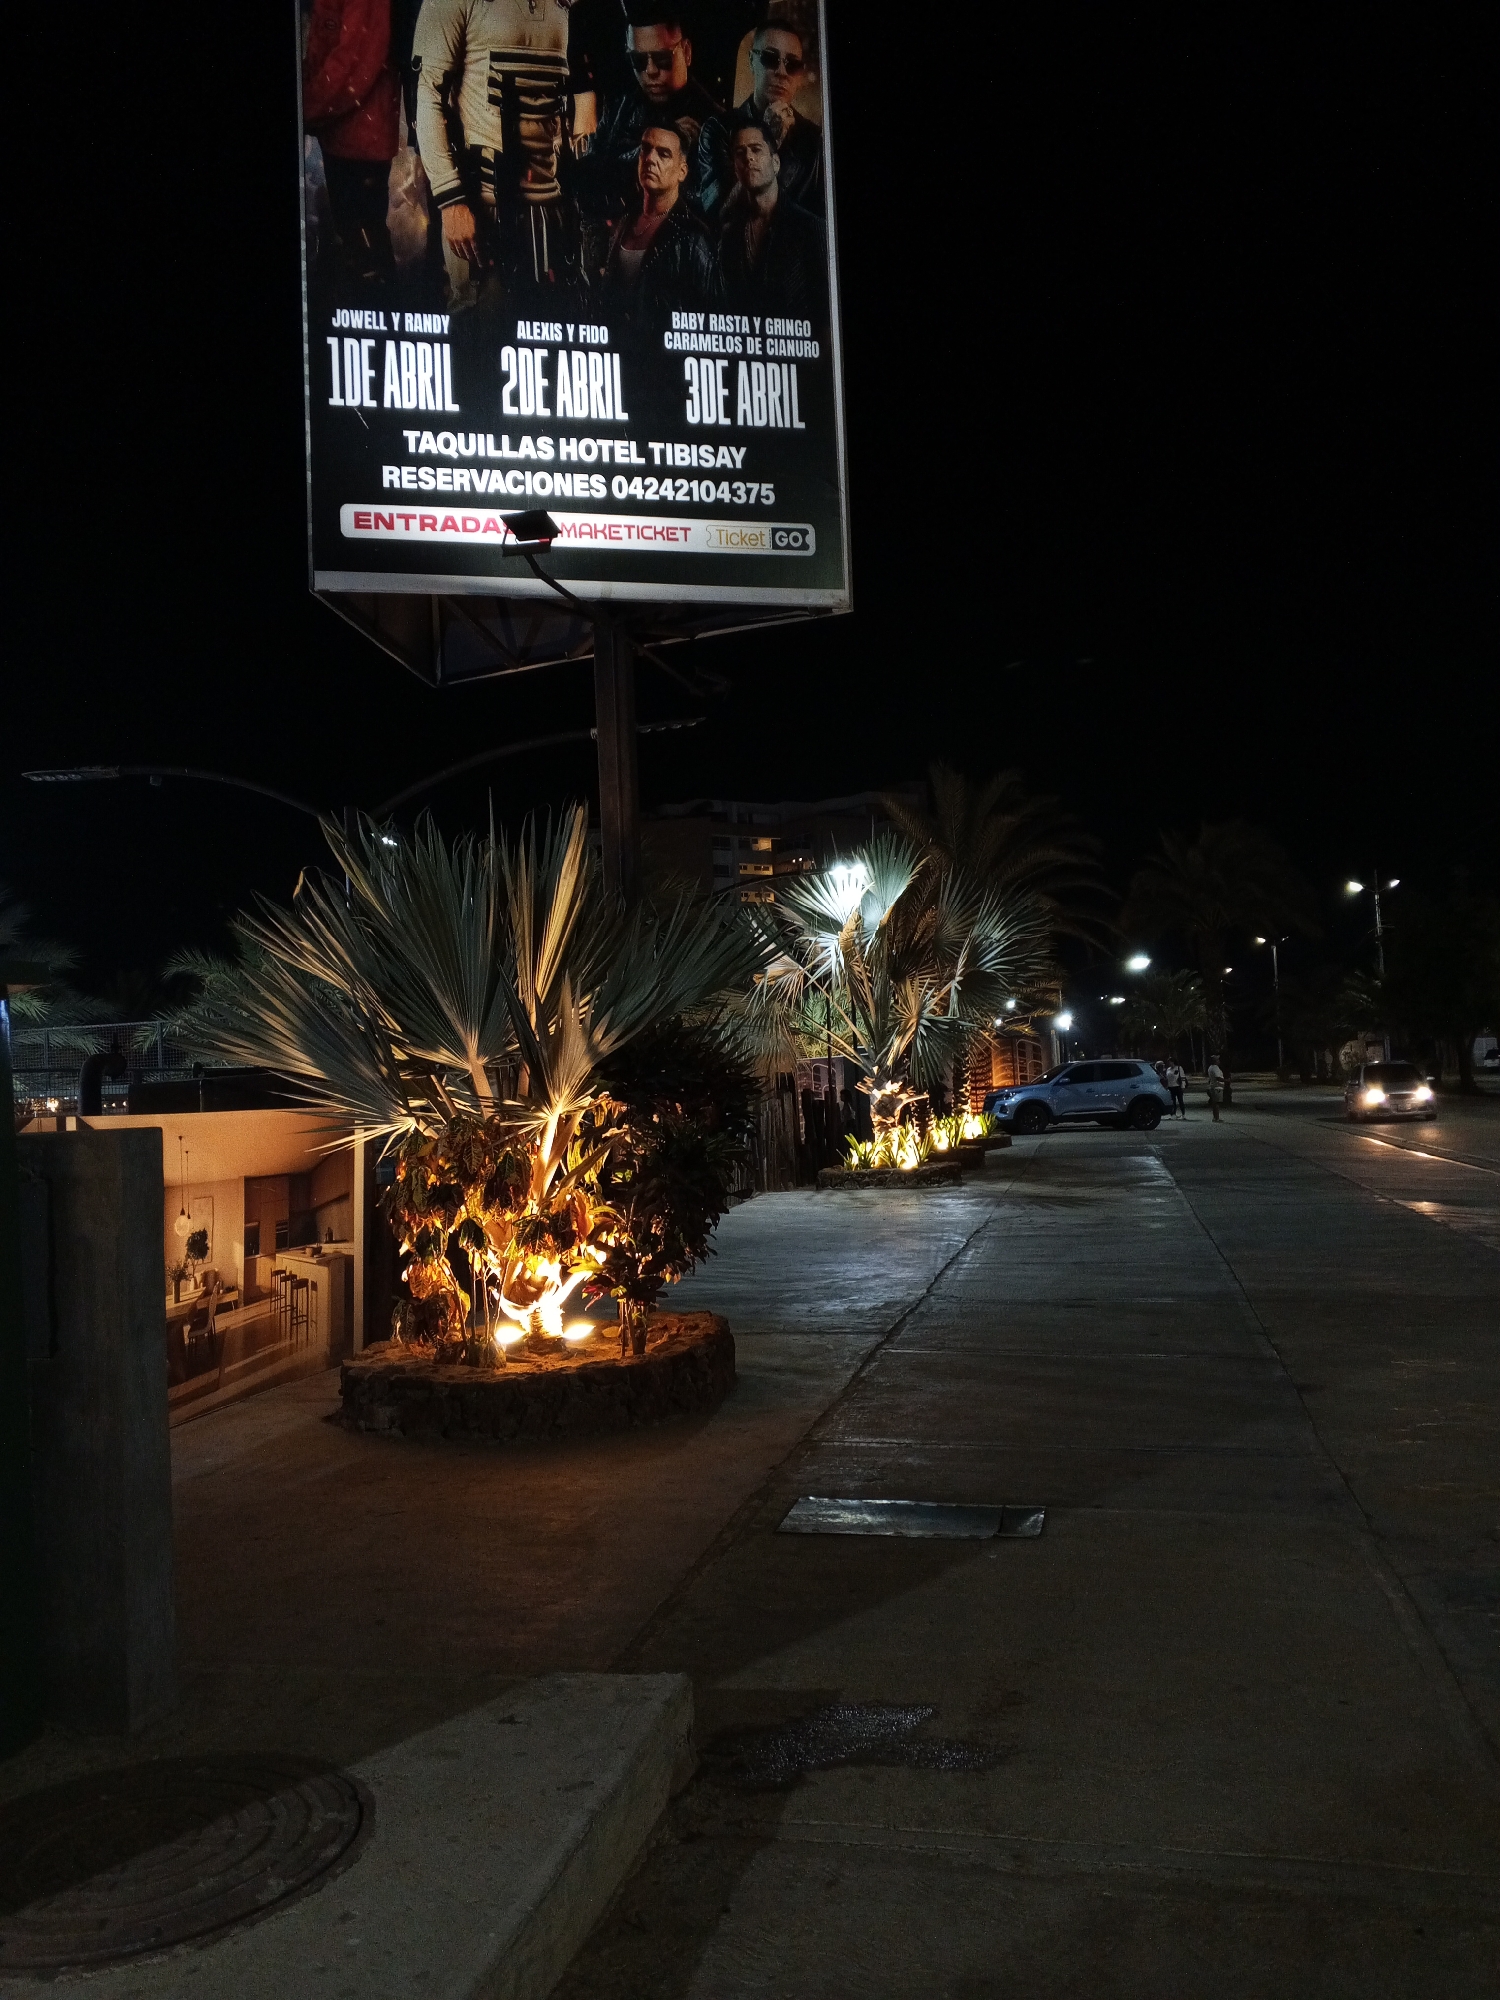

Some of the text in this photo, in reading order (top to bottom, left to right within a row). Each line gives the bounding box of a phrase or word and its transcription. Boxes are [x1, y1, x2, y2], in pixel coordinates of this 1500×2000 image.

[332, 309, 450, 334] JOWELL Y RANDY
[517, 321, 608, 344] ALEXIS Y FIDO
[672, 312, 810, 339] BABY RASTA Y GRINGO
[664, 331, 819, 358] CARAMELOS DE CIANURO
[384, 341, 459, 412] ABRIL
[556, 350, 628, 421] ABRIL
[738, 361, 805, 428] ABRIL
[403, 430, 746, 468] TAQUILLAS HOTEL TIBISAY
[383, 466, 775, 504] RESERVACIONES 04242104375
[560, 523, 691, 541] MAKETICKET
